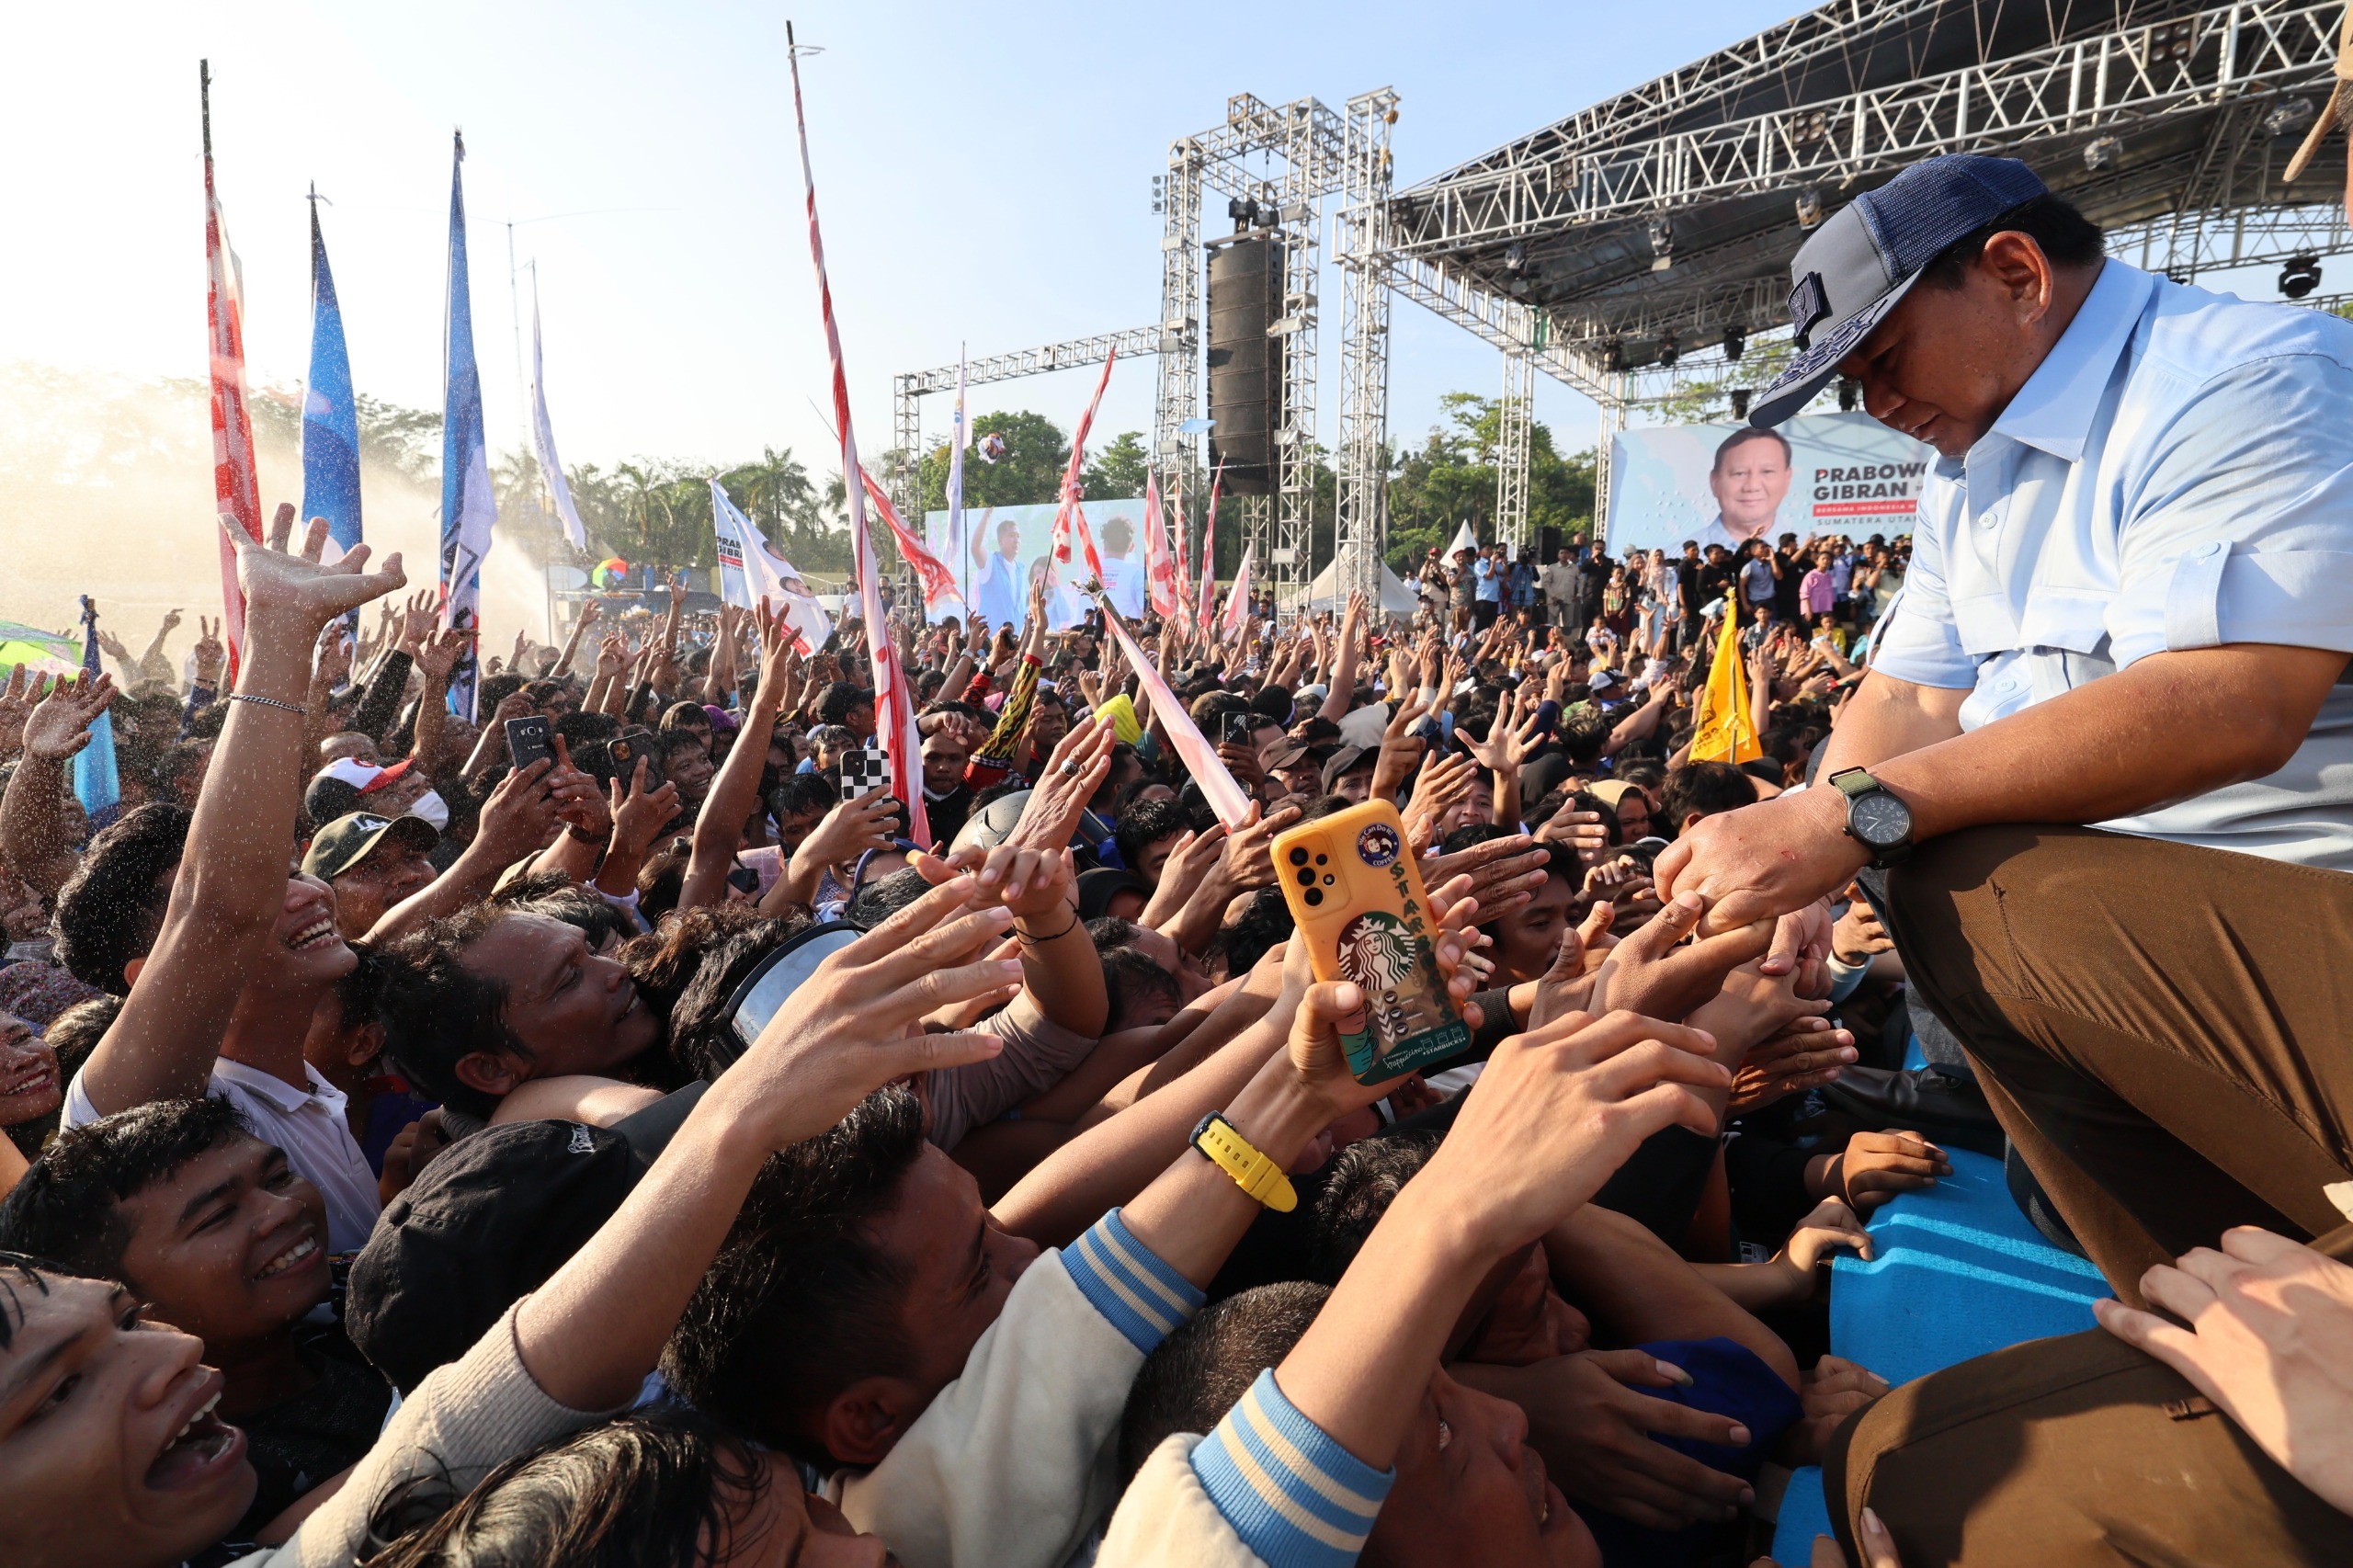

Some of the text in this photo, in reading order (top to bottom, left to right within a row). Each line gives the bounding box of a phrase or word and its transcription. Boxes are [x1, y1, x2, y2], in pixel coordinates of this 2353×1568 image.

[1813, 482, 1908, 500] GIBRAN
[1817, 516, 1882, 526] SUMATERA
[1364, 826, 1376, 835] Can
[1373, 855, 1394, 866] COFFEE
[1427, 1039, 1463, 1054] STARBUCKS
